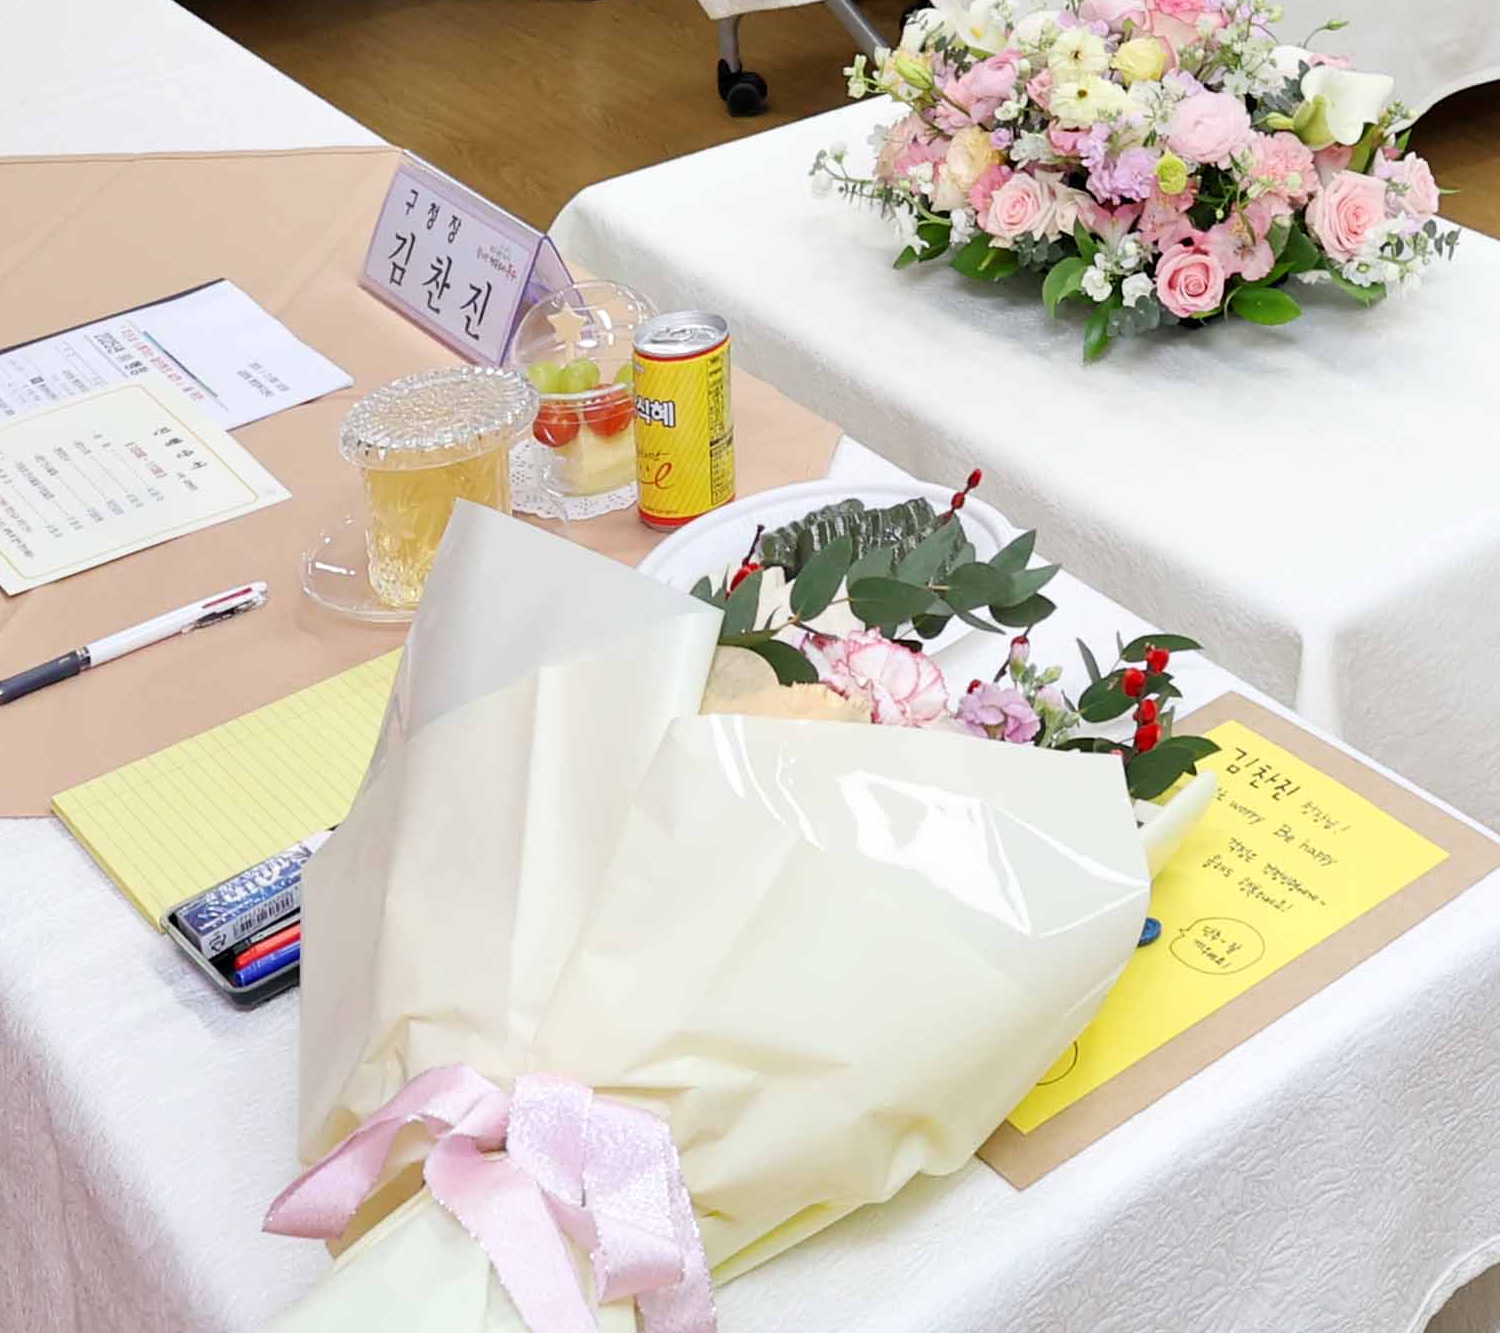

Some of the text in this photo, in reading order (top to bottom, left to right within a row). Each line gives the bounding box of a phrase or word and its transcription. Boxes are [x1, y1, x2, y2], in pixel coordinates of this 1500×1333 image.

[388, 232, 492, 341] 김찬진
[1225, 747, 1301, 801] 김찬진
[1273, 823, 1296, 843] Be
[1299, 838, 1339, 867] happy
